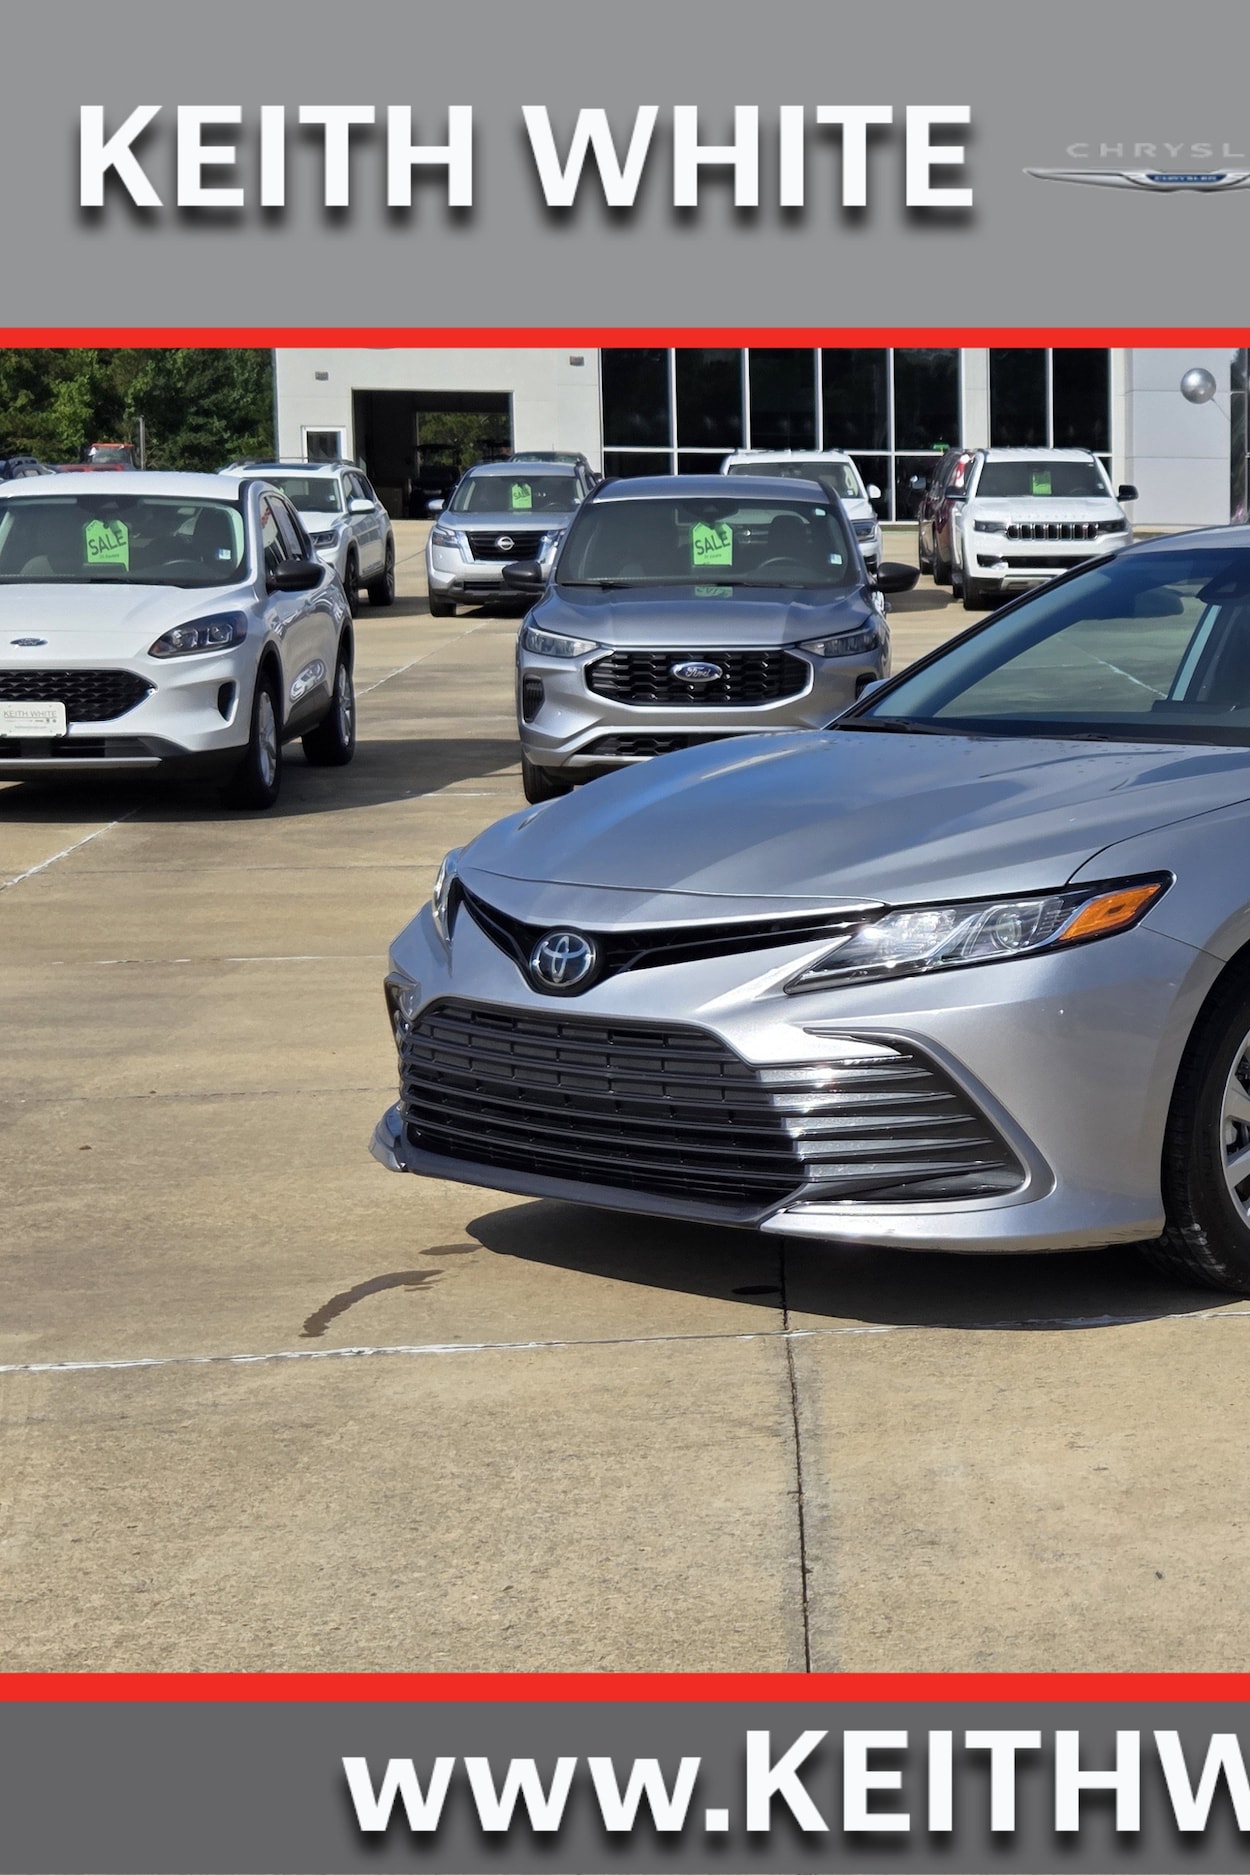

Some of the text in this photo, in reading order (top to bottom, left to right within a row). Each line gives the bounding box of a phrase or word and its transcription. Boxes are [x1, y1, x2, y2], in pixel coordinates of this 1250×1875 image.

[88, 529, 127, 556] SALE
[694, 531, 731, 556] SALE
[3, 710, 57, 718] KEITH WHITE
